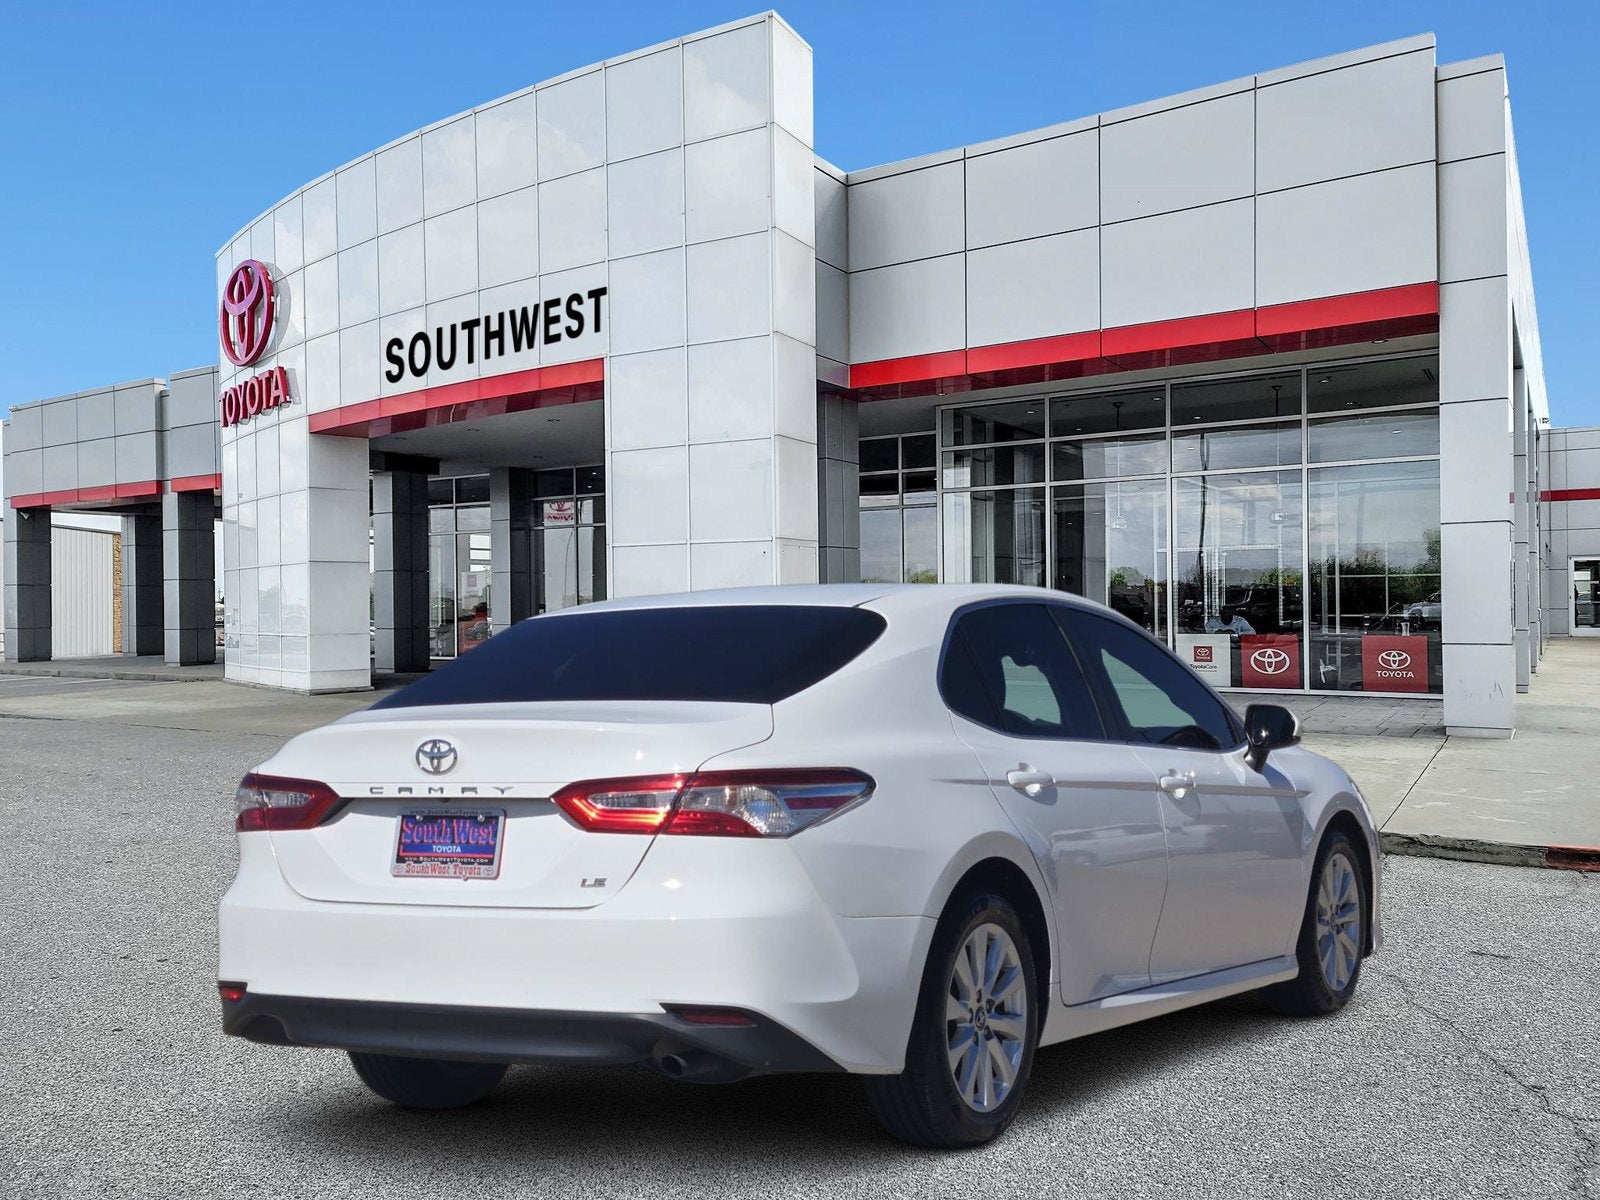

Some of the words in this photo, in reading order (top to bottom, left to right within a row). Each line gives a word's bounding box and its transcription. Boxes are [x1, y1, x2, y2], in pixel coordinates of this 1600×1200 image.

[385, 286, 607, 384] SOUTHWEST
[218, 366, 291, 427] TOYOTA
[1375, 670, 1415, 678] TOYOTA
[369, 786, 514, 795] CAMRY
[432, 845, 462, 853] TOYOTA
[453, 863, 480, 877] Toyota
[580, 877, 608, 888] LE
